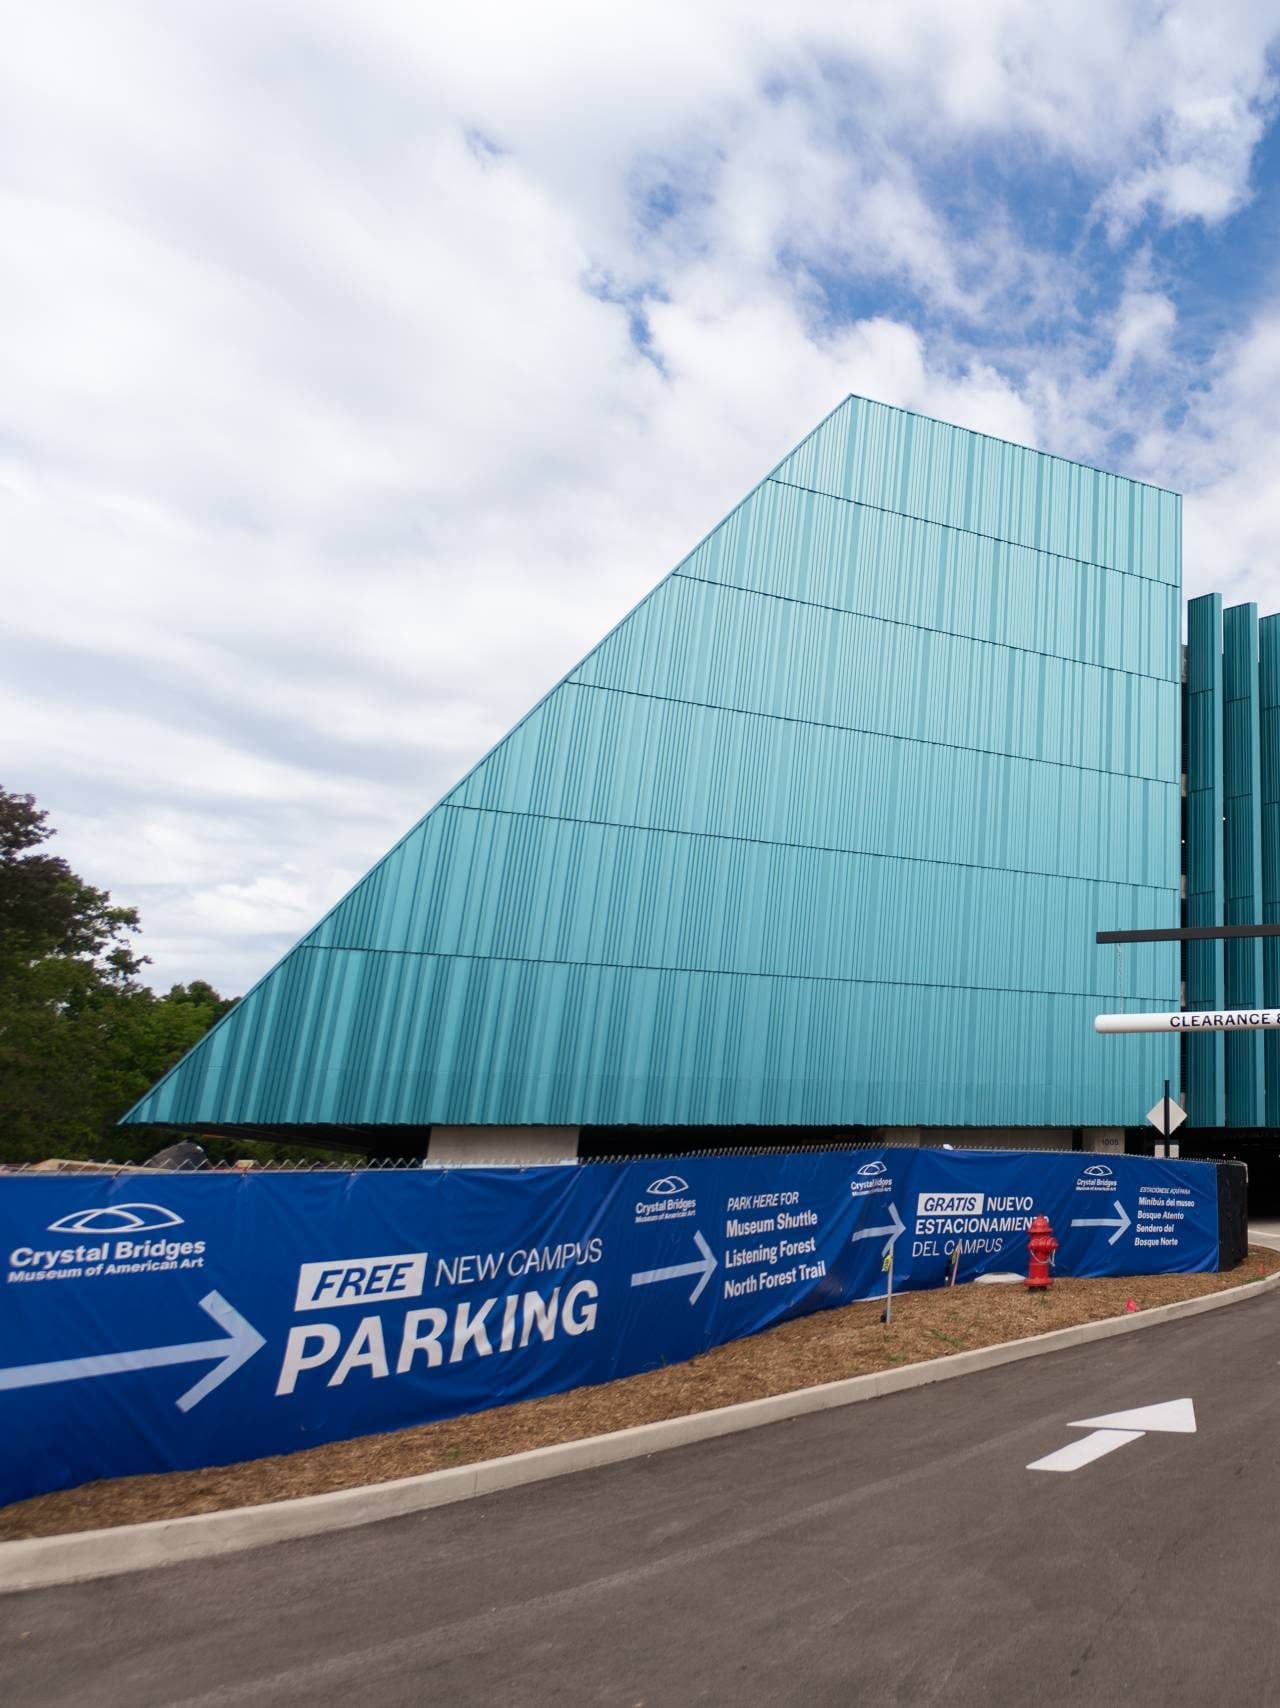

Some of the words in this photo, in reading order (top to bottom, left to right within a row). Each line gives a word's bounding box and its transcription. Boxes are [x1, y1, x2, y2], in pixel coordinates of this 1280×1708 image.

[1170, 1013, 1270, 1027] CLEARANCE
[635, 1200, 666, 1216] Crystal
[667, 1198, 696, 1211] Bridges
[727, 1195, 752, 1212] PARK
[752, 1193, 779, 1208] HERE
[780, 1191, 799, 1206] FOR
[924, 1197, 976, 1212] GRATIS
[986, 1196, 1034, 1212] NUEVO
[1166, 1199, 1175, 1207] del
[726, 1218, 774, 1238] Museum
[777, 1210, 818, 1230] Shuttle
[1137, 1210, 1161, 1220] Bosque
[1162, 1211, 1184, 1220] Atento
[915, 1216, 1049, 1235] ESTACIONAMIEN
[1136, 1224, 1163, 1232] Sendero
[1164, 1224, 1175, 1232] del
[912, 1241, 940, 1257] DEL
[1134, 1237, 1159, 1247] Bosque
[1160, 1237, 1179, 1246] Norte
[10, 1243, 109, 1269] Crystal
[115, 1239, 206, 1260] Bridges
[725, 1245, 778, 1268] Listening
[780, 1236, 816, 1257] Forest
[7, 1266, 81, 1283] Museum
[85, 1263, 104, 1277] of
[105, 1260, 177, 1275] American
[180, 1257, 204, 1268] Art
[311, 1261, 415, 1301] FREE
[435, 1252, 504, 1287] NEW
[507, 1238, 602, 1277] CAMPUS
[724, 1275, 757, 1299] North
[759, 1267, 797, 1290] Forest
[799, 1260, 826, 1280] Trail
[274, 1279, 599, 1397] PARKING
